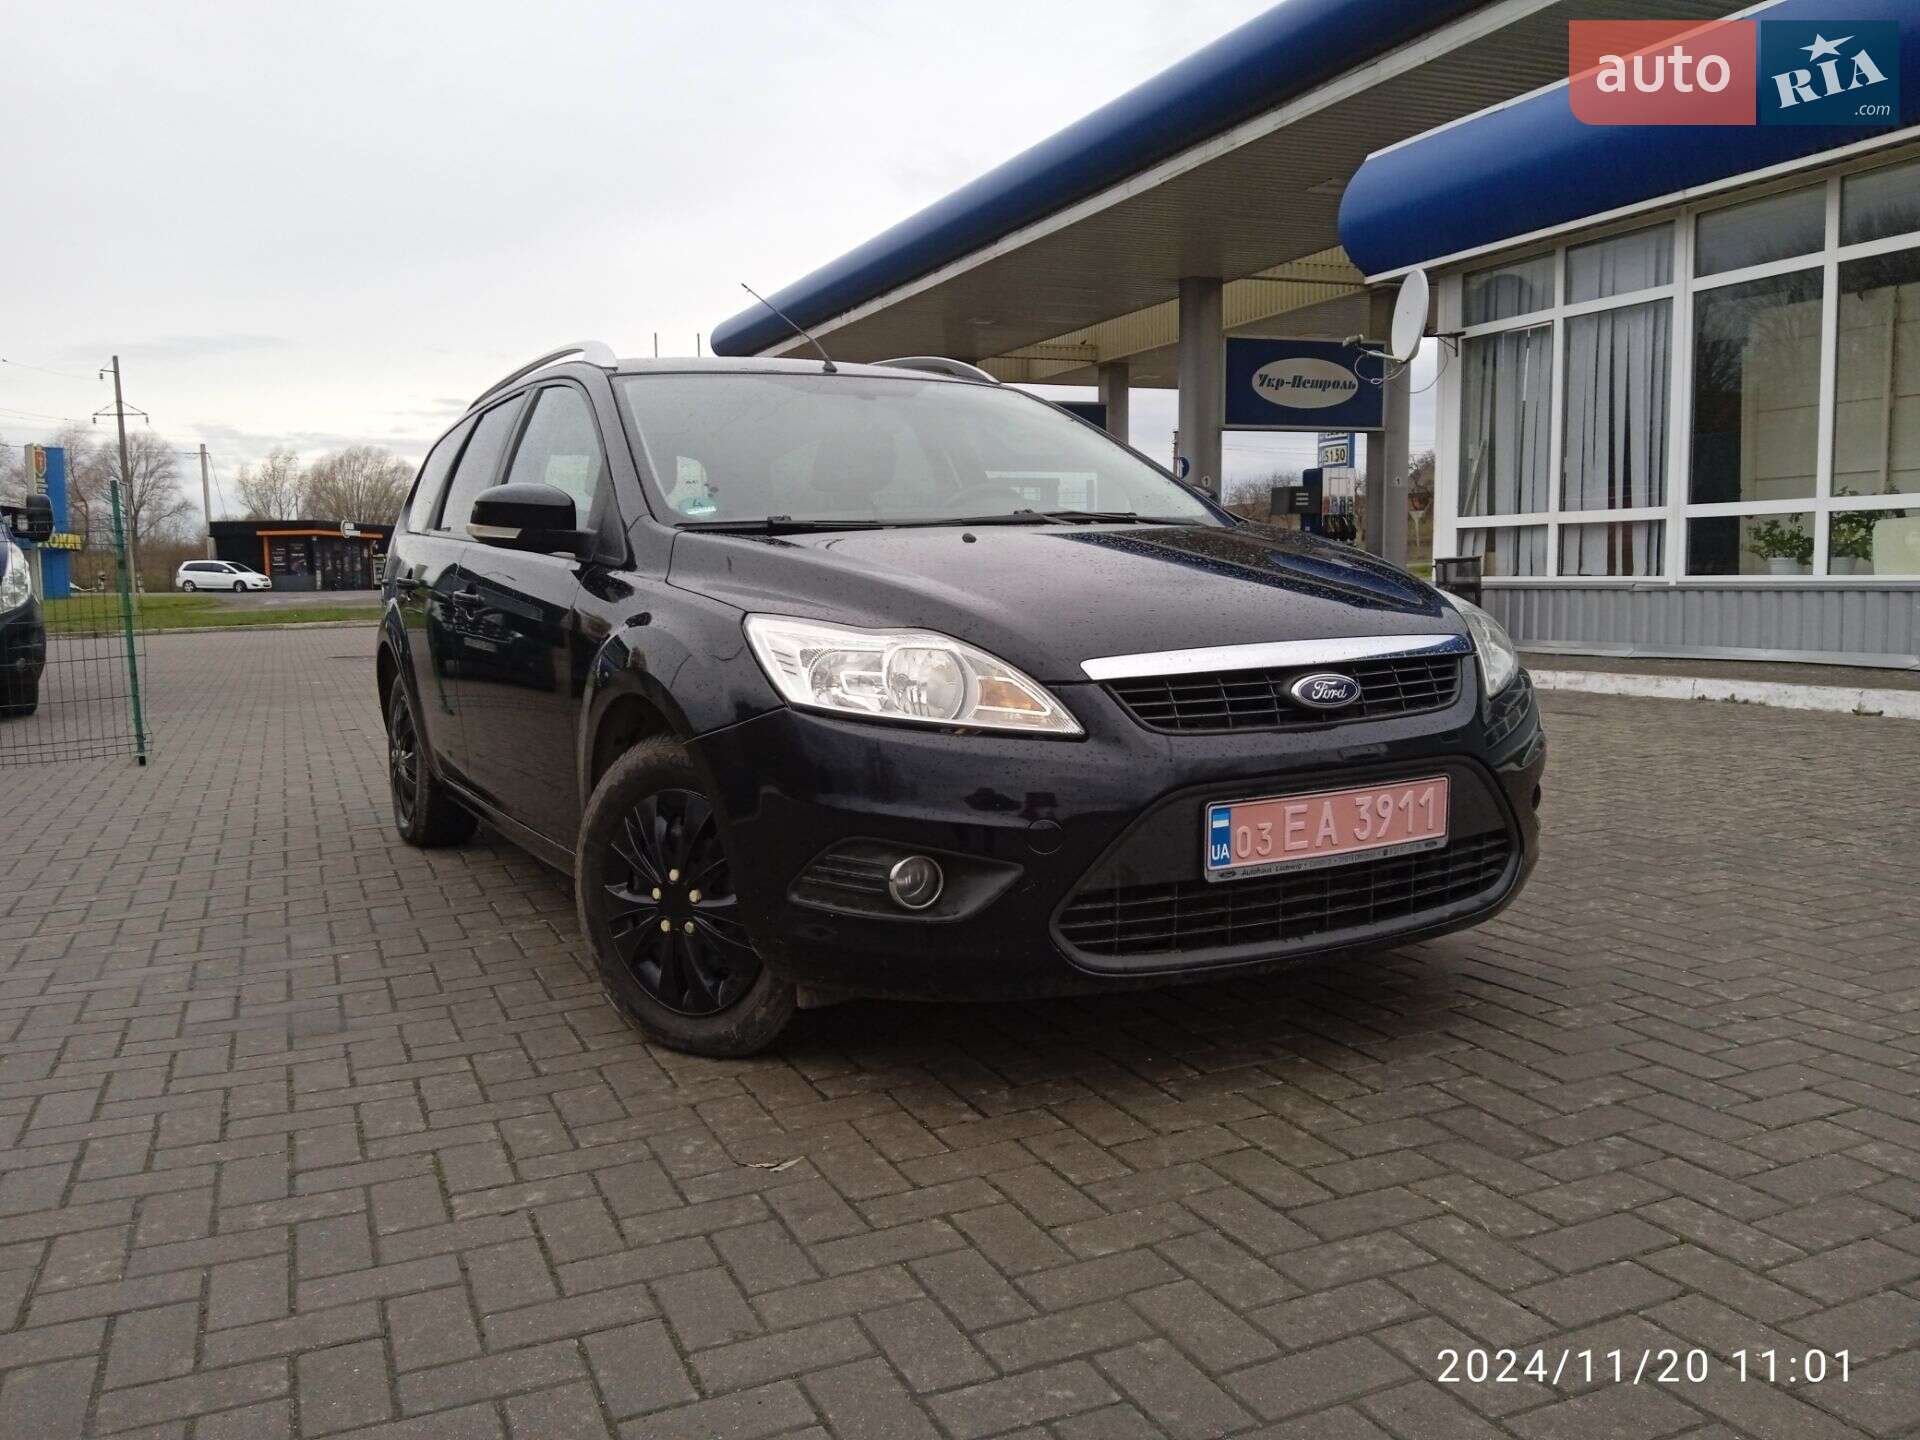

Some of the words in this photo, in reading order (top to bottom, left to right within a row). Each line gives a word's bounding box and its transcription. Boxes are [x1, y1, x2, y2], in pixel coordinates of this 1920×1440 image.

[1258, 374, 1357, 392] Укр-Петроль
[1311, 680, 1348, 700] Ford
[1235, 822, 1273, 859] 03
[1283, 801, 1339, 852] EA
[1353, 786, 1436, 842] 3911
[1211, 843, 1231, 861] UA
